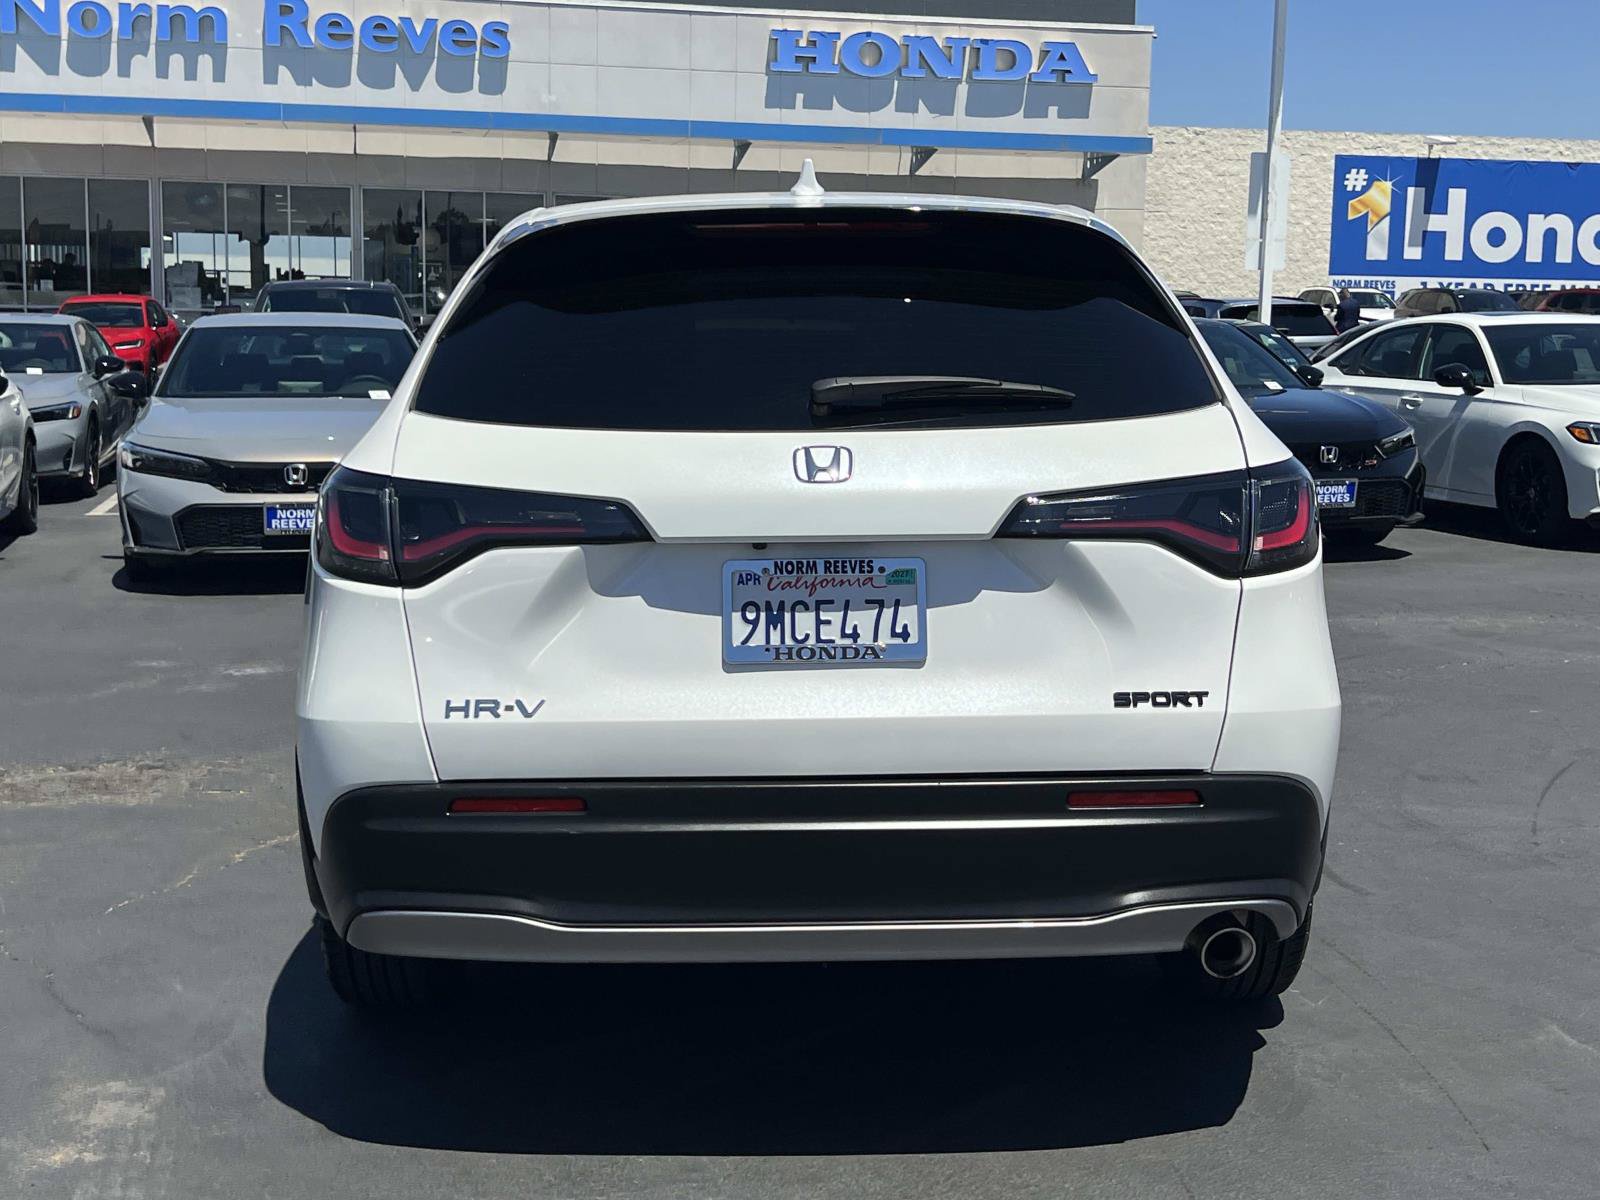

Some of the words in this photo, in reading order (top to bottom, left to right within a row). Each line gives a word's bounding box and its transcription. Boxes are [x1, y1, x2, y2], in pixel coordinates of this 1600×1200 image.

[0, 0, 229, 44] Norm
[264, 0, 511, 58] Reeves
[770, 28, 1098, 84] HONDA
[1332, 279, 1361, 288] NORM
[1363, 279, 1396, 289] REEVES
[1315, 485, 1347, 494] NORM
[1317, 493, 1351, 503] EEVES
[271, 518, 315, 529] REEVE
[773, 560, 818, 575] NORM
[824, 559, 874, 575] REEVES
[736, 572, 761, 586] APR
[767, 574, 888, 597] California
[740, 598, 911, 645] 9MCE474
[772, 646, 883, 661] HONDA
[1113, 691, 1209, 708] SPORT
[444, 699, 546, 719] HR-V
